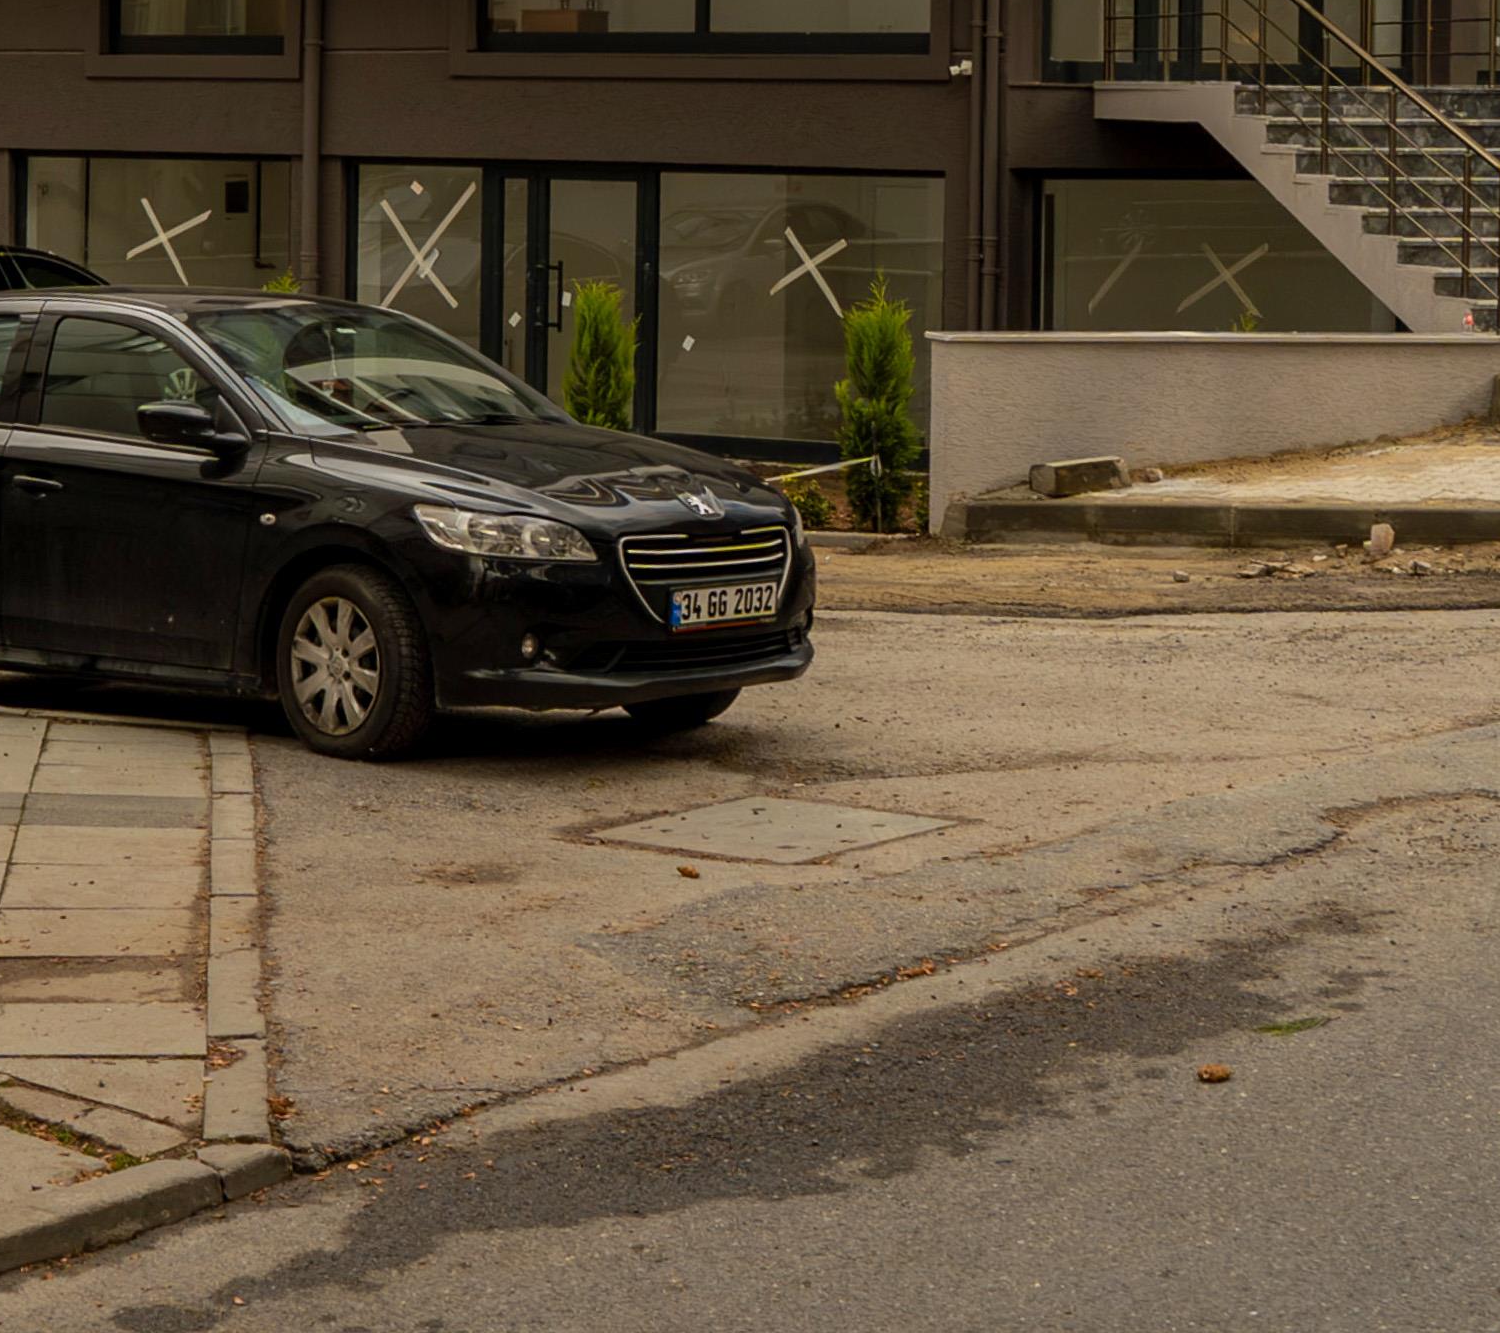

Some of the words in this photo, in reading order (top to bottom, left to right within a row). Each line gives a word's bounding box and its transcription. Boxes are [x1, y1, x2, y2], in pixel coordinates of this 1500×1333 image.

[681, 592, 702, 621] 34
[707, 589, 728, 619] GG
[733, 585, 774, 615] 2032
